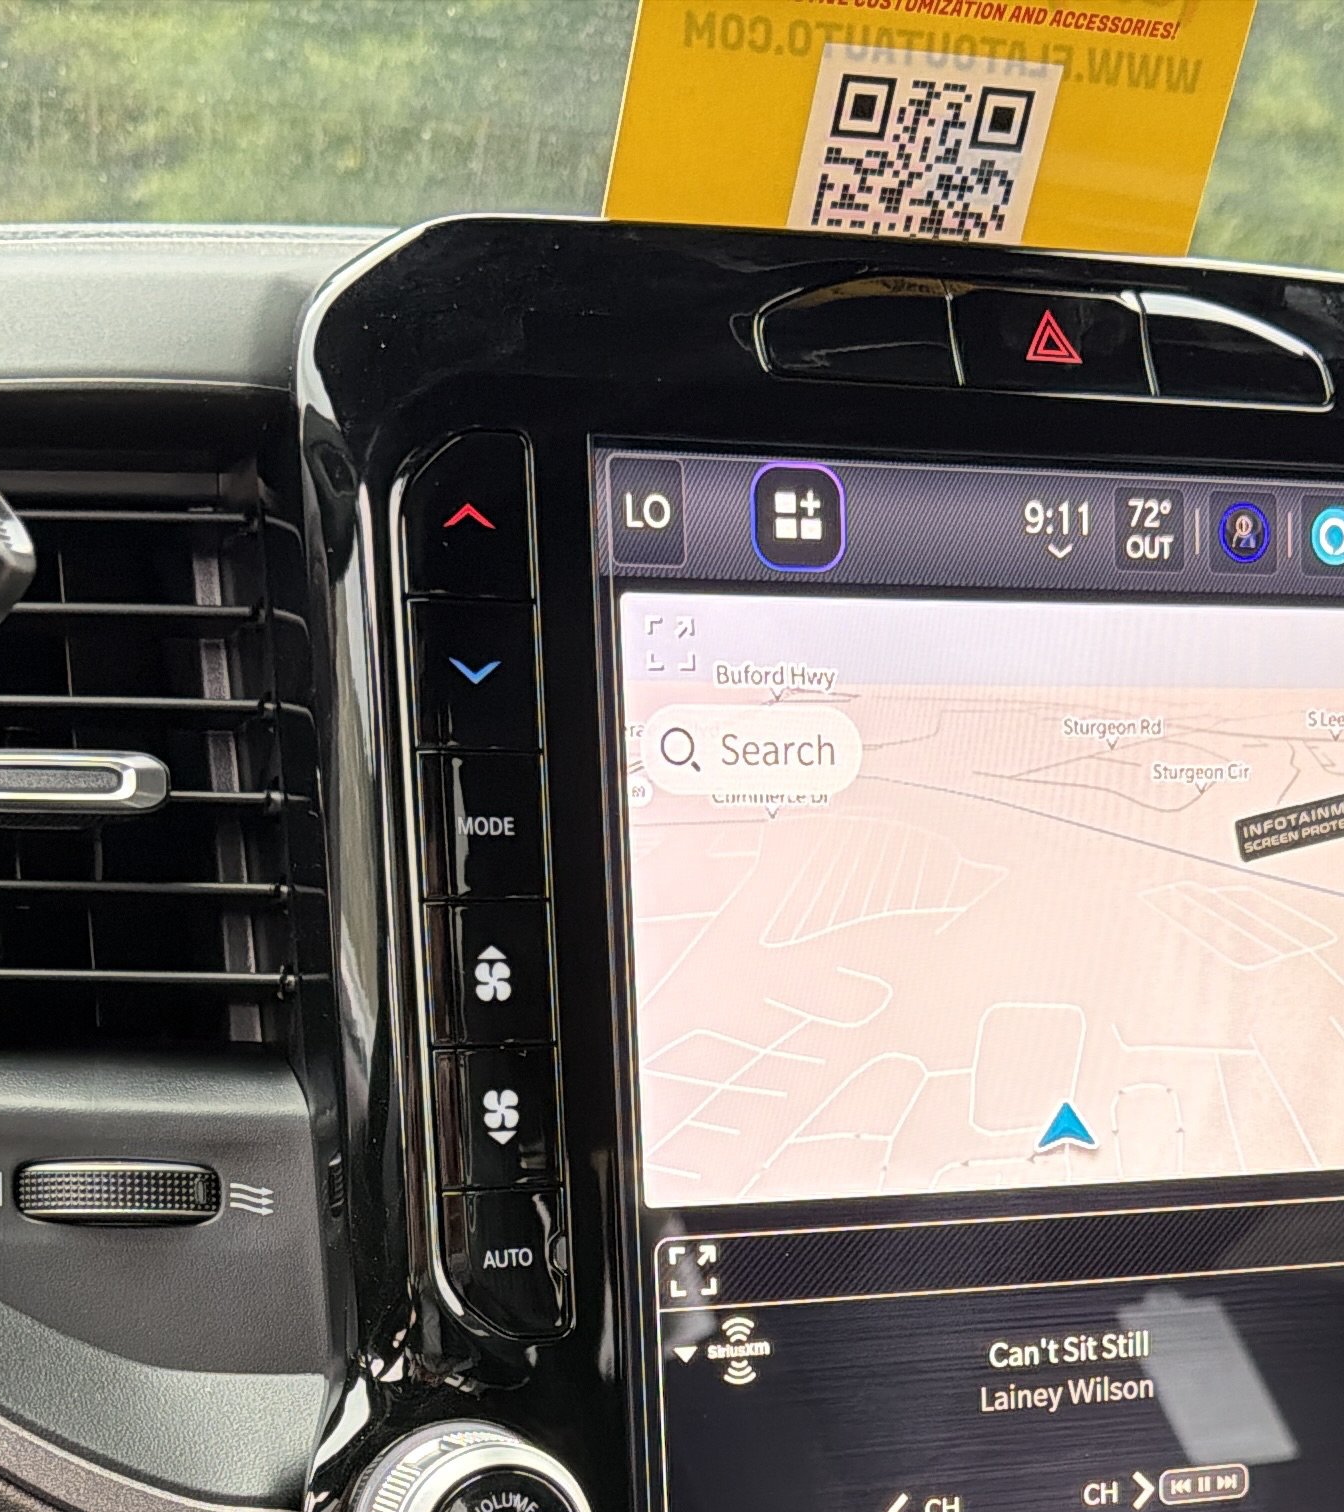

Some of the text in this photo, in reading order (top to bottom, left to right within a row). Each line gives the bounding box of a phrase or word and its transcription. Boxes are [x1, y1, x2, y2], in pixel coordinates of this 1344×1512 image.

[1009, 6, 1049, 26] AND
[1049, 10, 1181, 40] ACCESSORIES!
[623, 491, 672, 529] LO
[1023, 500, 1093, 536] 9:11
[1127, 498, 1172, 528] 72°
[1126, 534, 1175, 560] OUT
[716, 665, 836, 690] Buford Hwy
[1063, 719, 1162, 737] Sturgeon Rd
[1308, 712, 1318, 728] S
[721, 734, 836, 767] Search
[1153, 763, 1222, 782] Sturgeon
[457, 816, 516, 836] MODE
[1244, 830, 1299, 854] SCREEN
[483, 1248, 533, 1269] AUTO
[989, 1331, 1149, 1368] Can't Sit Still
[981, 1377, 1154, 1413] Lainey Wilson
[1084, 1482, 1118, 1505] CH
